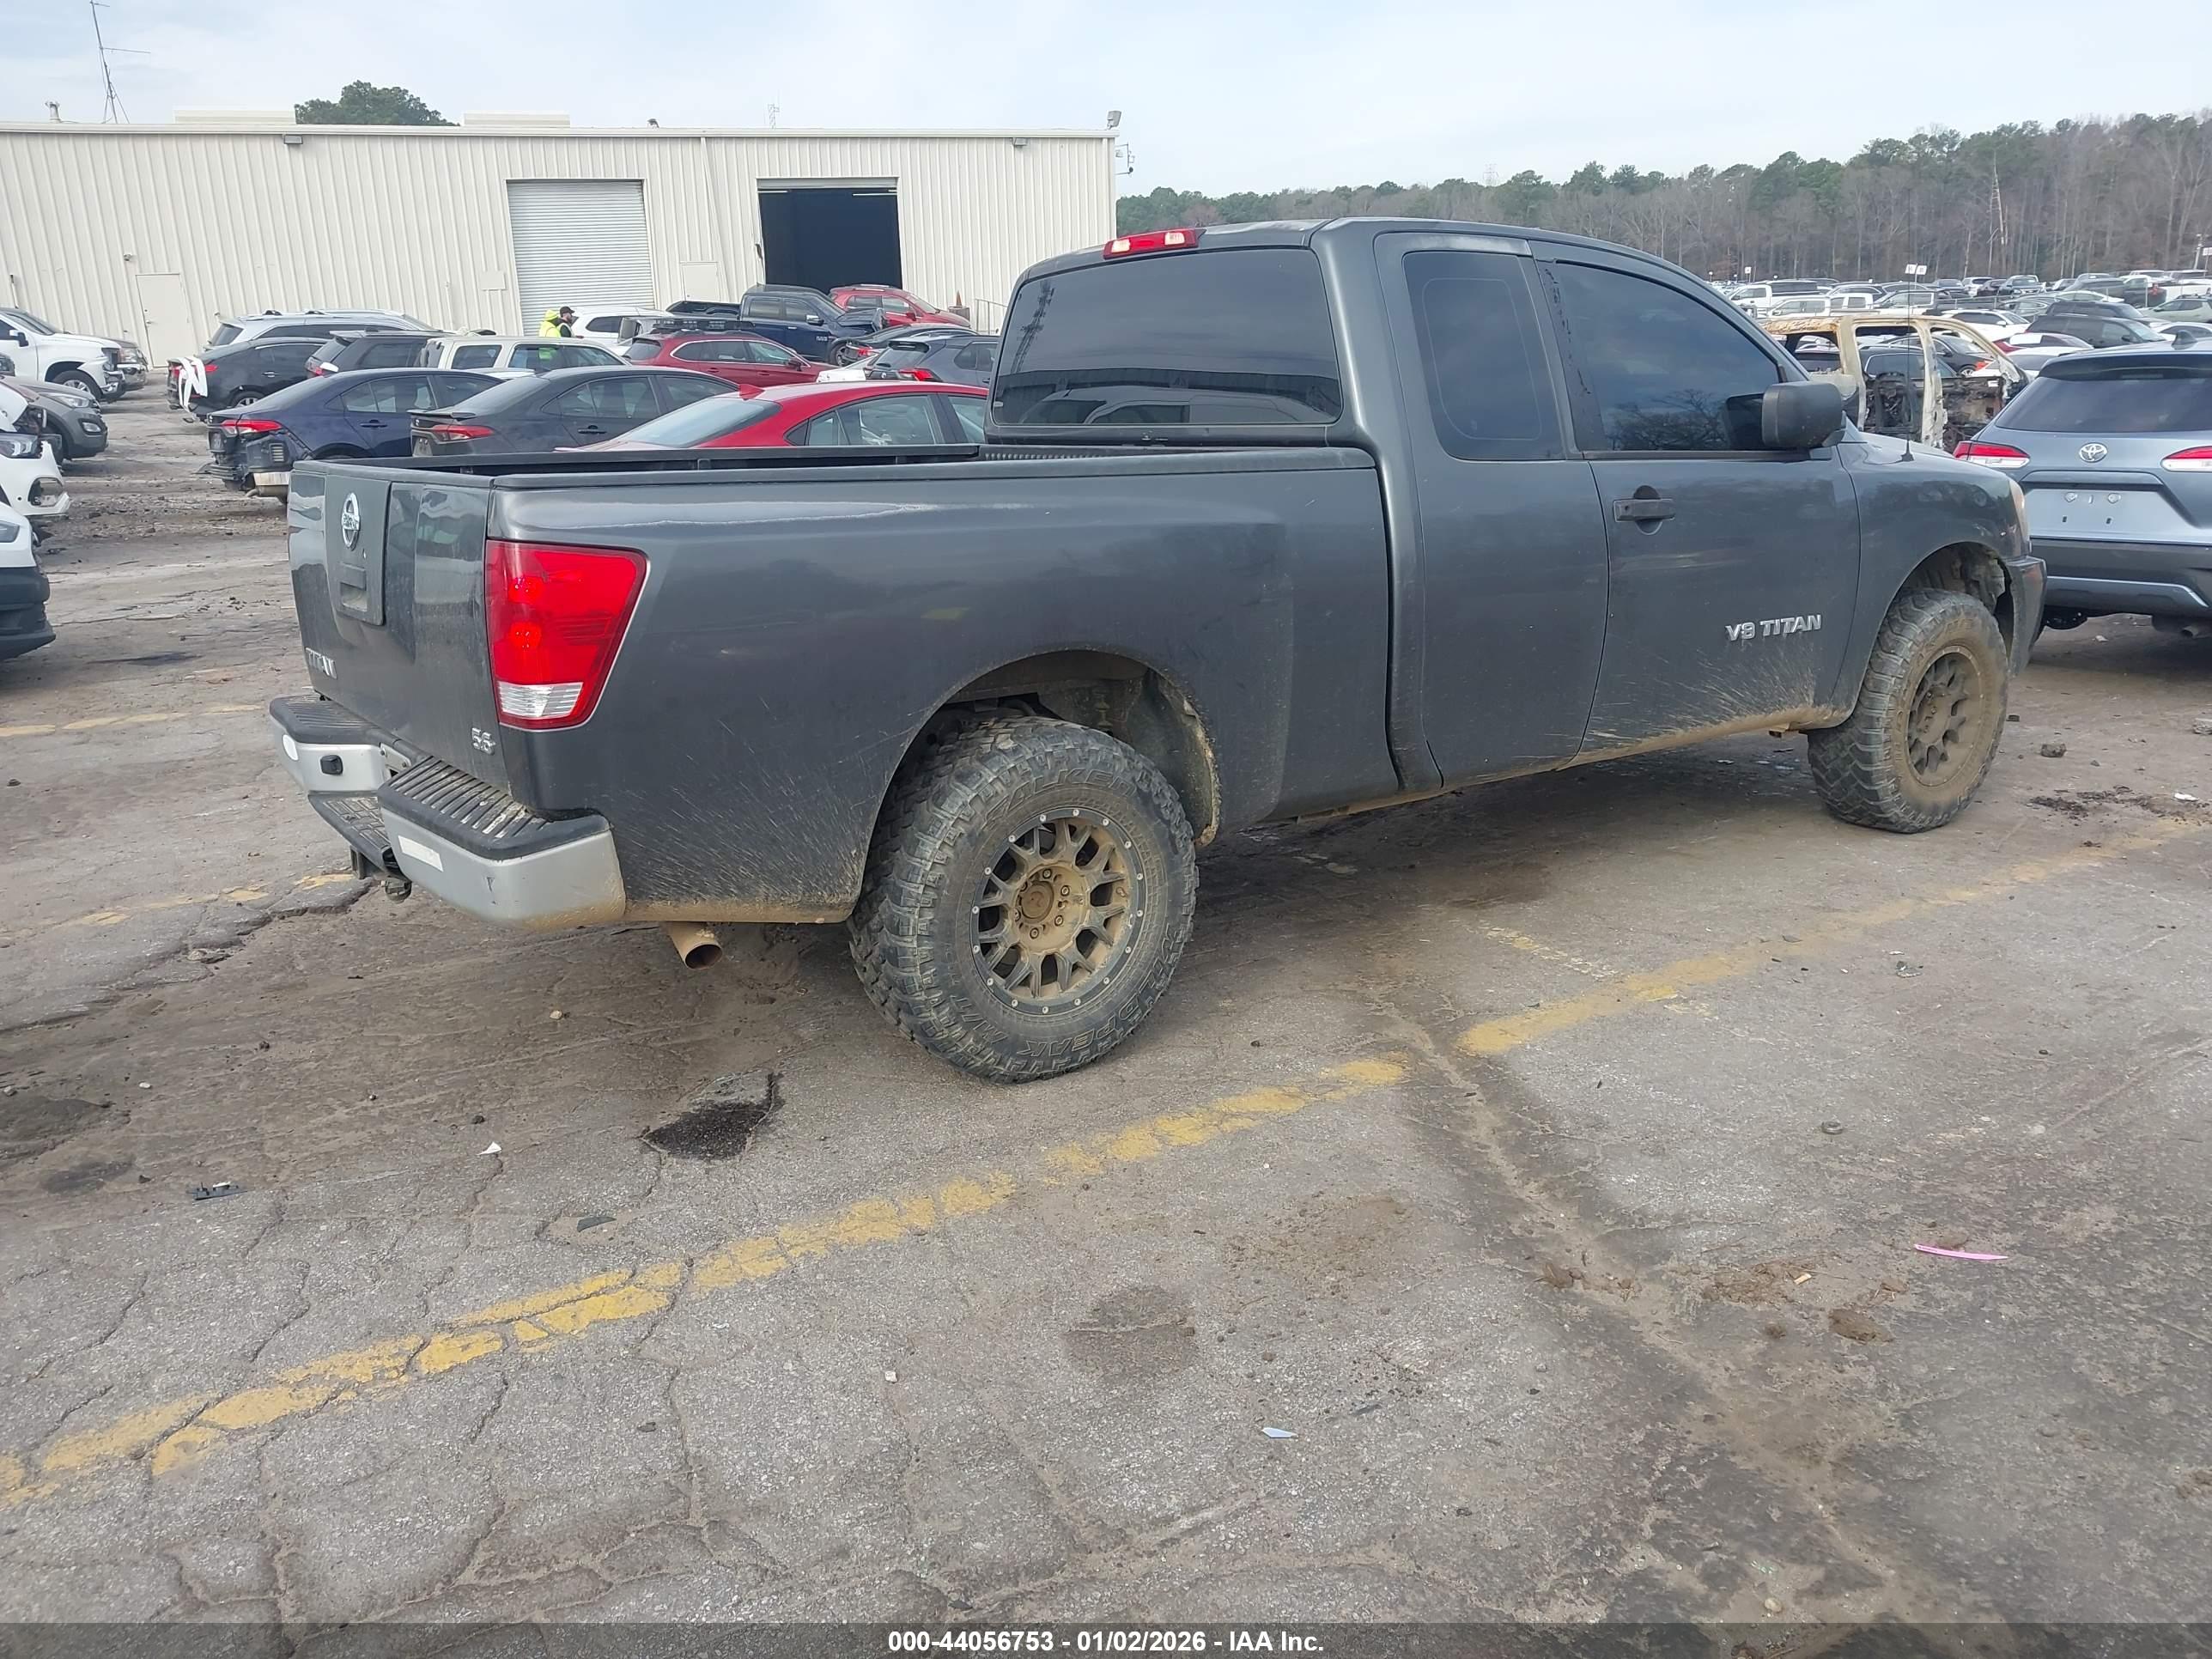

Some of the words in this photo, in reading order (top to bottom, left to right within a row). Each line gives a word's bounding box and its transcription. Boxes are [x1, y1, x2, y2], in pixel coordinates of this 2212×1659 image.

[1725, 622, 1756, 641] V8
[1759, 614, 1822, 637] TITAN
[981, 767, 1137, 831] FALKEN
